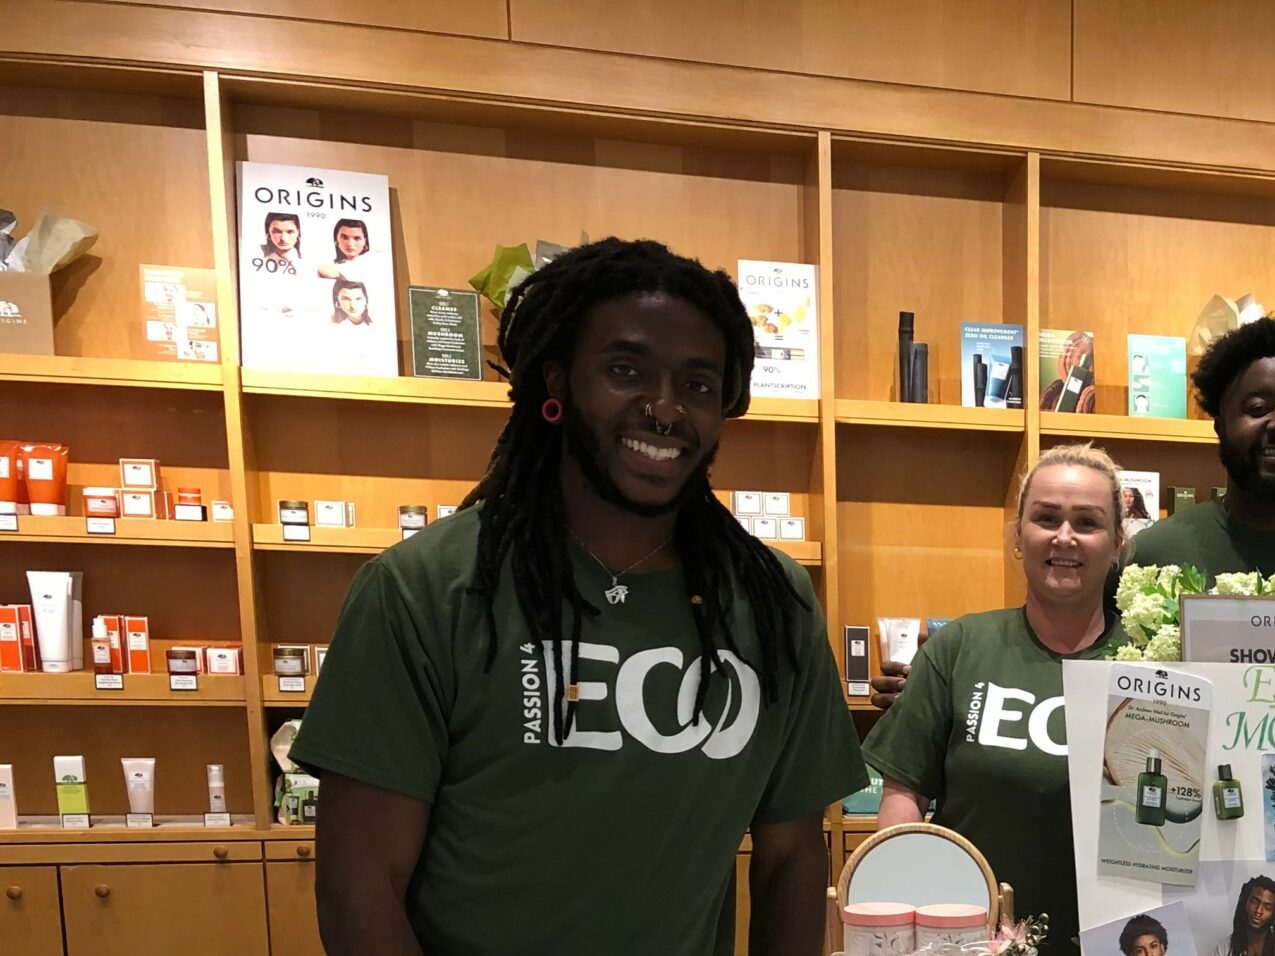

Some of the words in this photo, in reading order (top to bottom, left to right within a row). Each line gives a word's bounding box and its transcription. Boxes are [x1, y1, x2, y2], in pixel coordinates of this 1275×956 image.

[255, 187, 372, 213] ORIGINS
[252, 257, 297, 276] 90%
[746, 275, 808, 289] ORIGINS
[519, 642, 536, 653] 4
[974, 681, 985, 689] 4
[1117, 675, 1201, 702] ORIGINS
[520, 660, 541, 744] PASSION
[541, 639, 760, 760] ECO
[966, 691, 984, 743] PASSION
[978, 682, 1068, 756] EC
[1125, 713, 1190, 728] MEGA-MUSHROOM
[1170, 786, 1202, 798] +128%
[1161, 866, 1193, 874] MOISTURIZER
